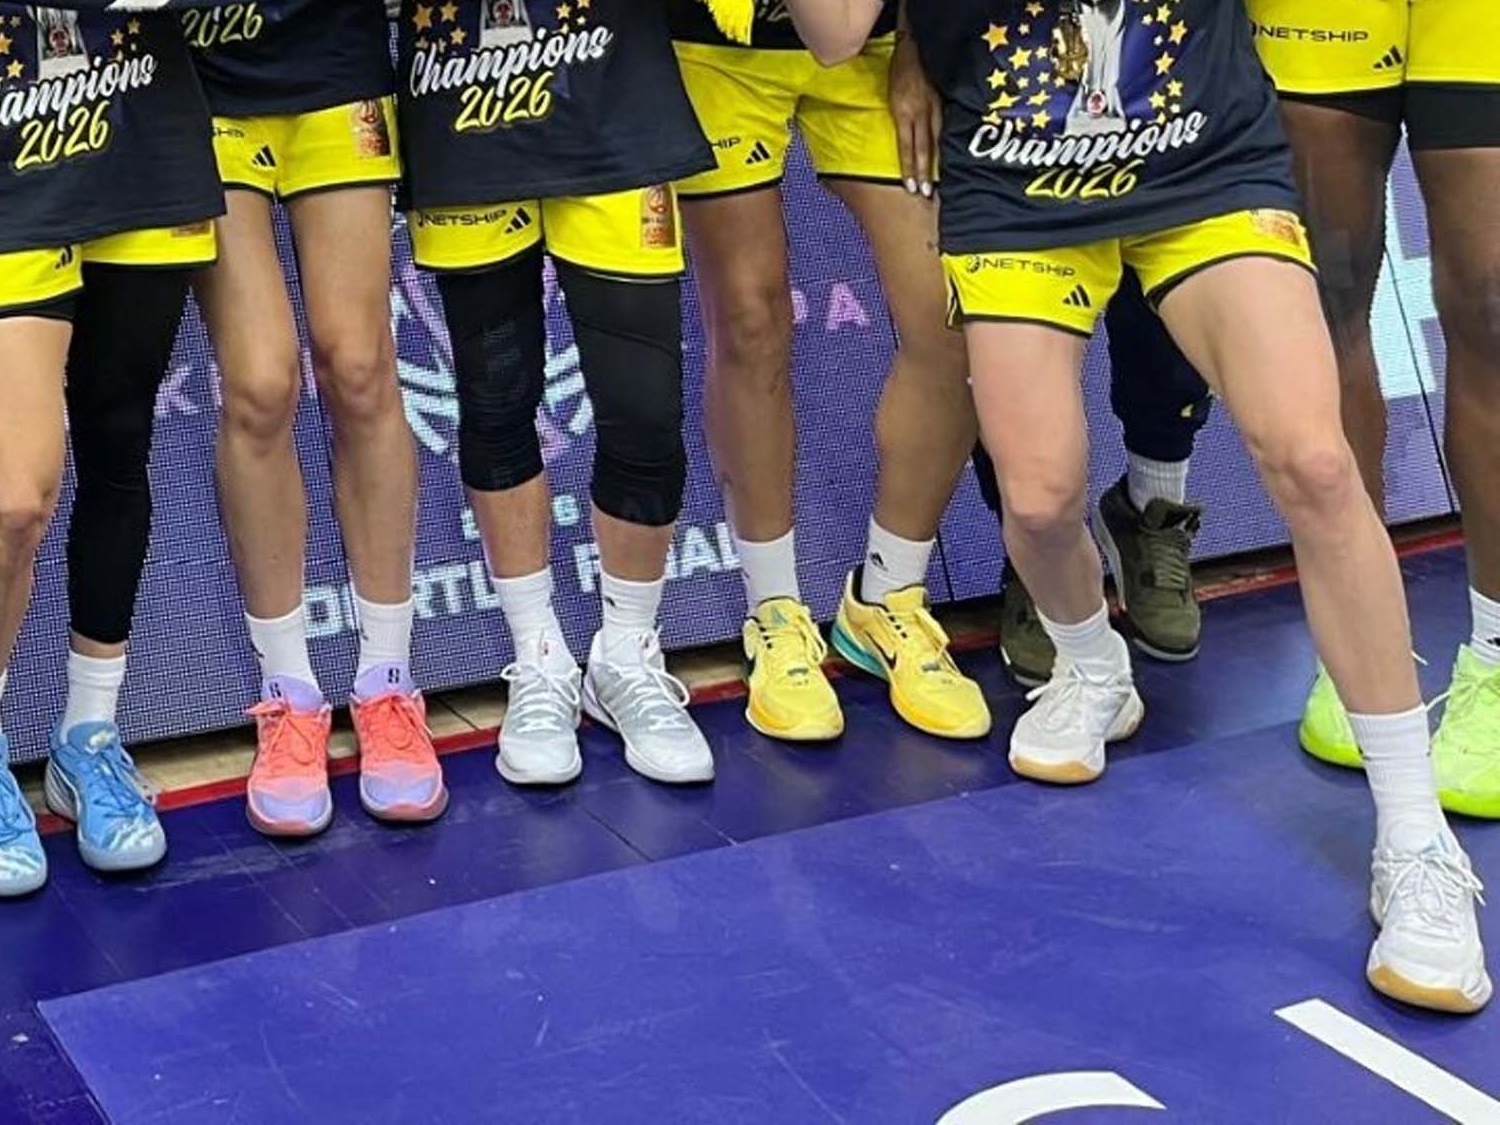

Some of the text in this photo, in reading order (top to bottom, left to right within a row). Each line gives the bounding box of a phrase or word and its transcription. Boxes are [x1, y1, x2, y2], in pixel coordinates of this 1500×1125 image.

[1259, 25, 1369, 44] NETSHIP
[409, 23, 614, 99] Champions
[454, 71, 554, 133] 2026
[13, 99, 112, 172] 2026
[968, 110, 1207, 174] Champions
[1024, 159, 1146, 201] 2026
[424, 209, 507, 227] NETSHIP
[982, 257, 1077, 278] NETSHIP
